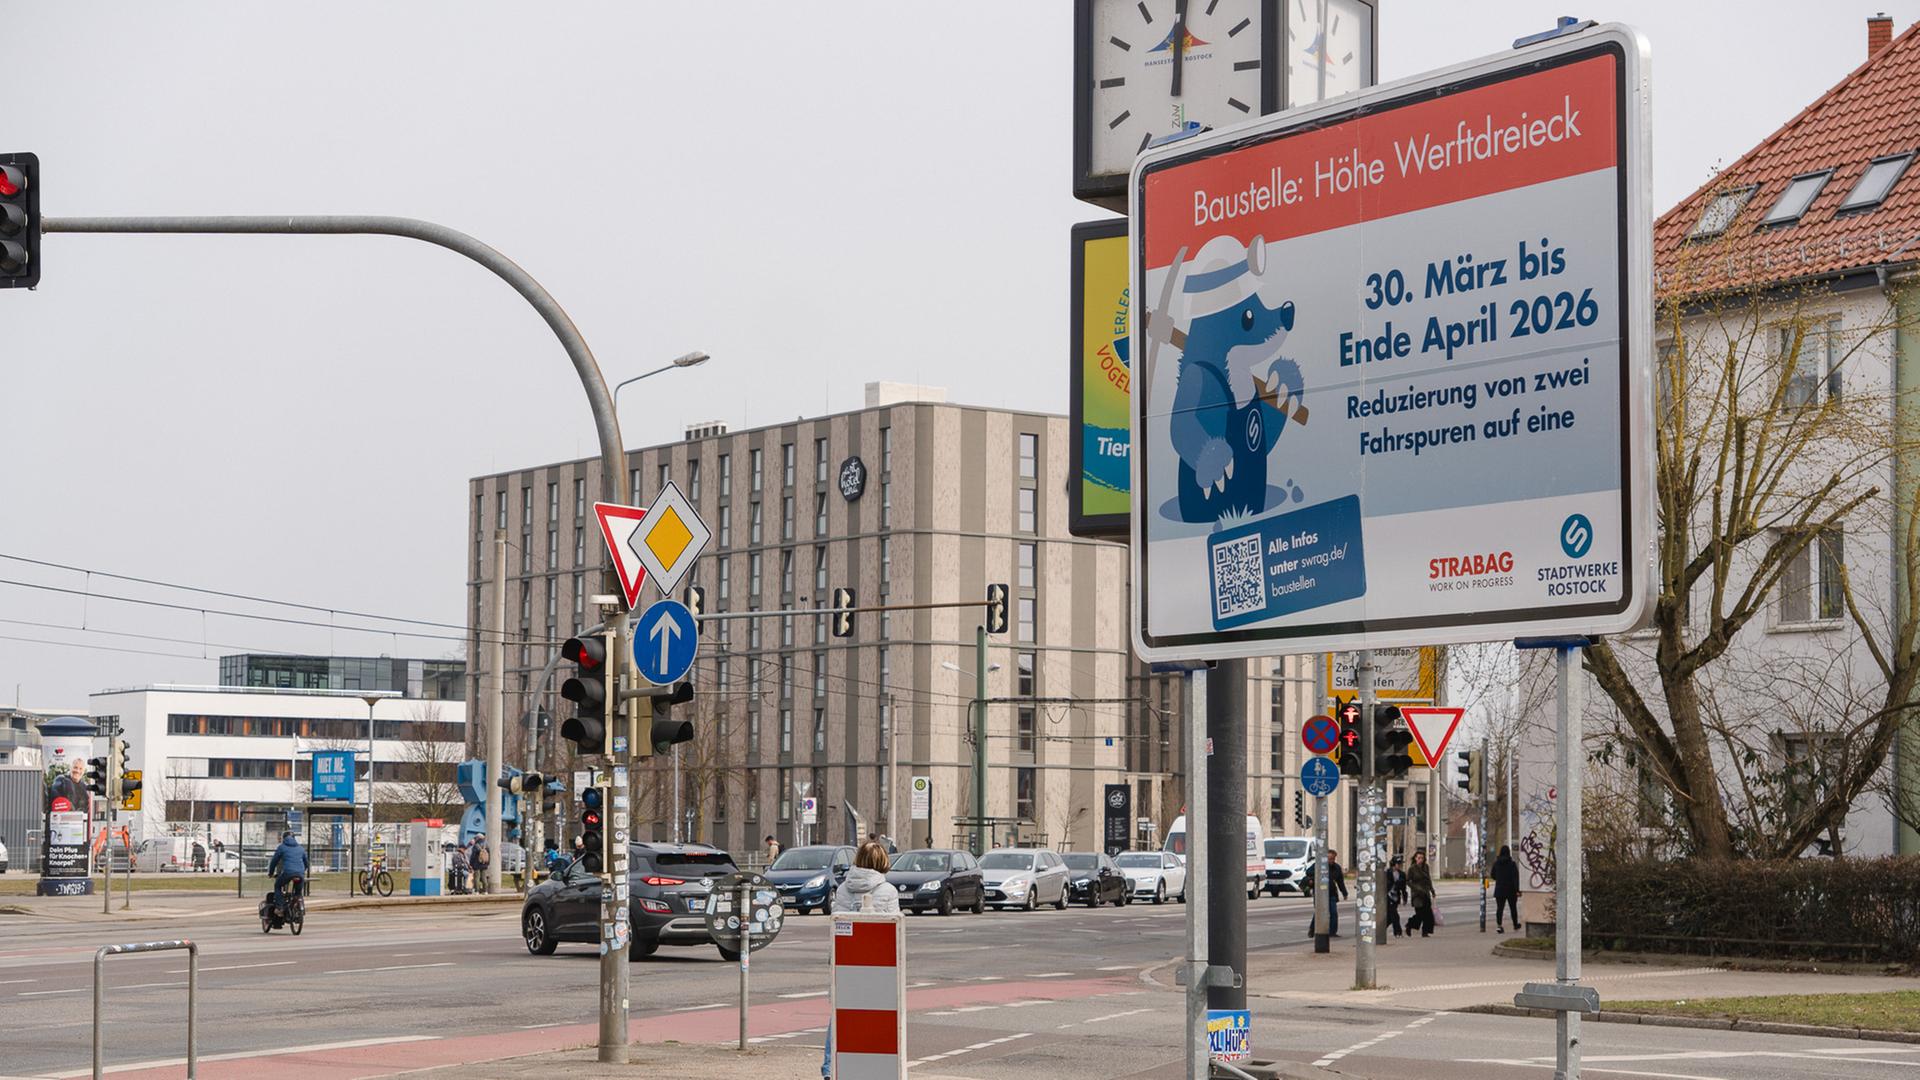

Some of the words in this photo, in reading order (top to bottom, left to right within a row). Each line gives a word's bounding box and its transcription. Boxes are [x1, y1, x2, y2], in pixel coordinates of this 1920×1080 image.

[1194, 166, 1303, 226] Baustelle:
[1315, 148, 1385, 198] Höhe
[1394, 95, 1582, 178] Werftdreieck
[1365, 269, 1413, 310] 30.
[1424, 253, 1507, 299] März
[1519, 237, 1566, 281] bis
[1340, 322, 1411, 367] Ende
[1421, 302, 1497, 360] April
[1509, 288, 1599, 339] 2026
[1347, 383, 1477, 419] Reduzierung
[1484, 375, 1526, 399] von
[1534, 357, 1589, 392] zwei
[1360, 422, 1476, 456] Fahrspuren
[1483, 408, 1520, 439] auf
[1527, 405, 1575, 434] eine
[840, 467, 860, 489] hotel
[1268, 537, 1289, 555] Alle
[1291, 531, 1319, 549] Infos
[1270, 559, 1299, 576] unter
[1301, 541, 1348, 567] swrag.de/
[1429, 551, 1514, 580] STRABAG
[1537, 561, 1618, 582] STADTWERKE
[1271, 575, 1316, 597] baustellen
[1429, 581, 1454, 593] WORK
[1456, 580, 1470, 591] ON
[1472, 576, 1514, 590] PROGRESS
[1548, 578, 1607, 597] ROSTOCK
[1208, 1029, 1223, 1052] XL
